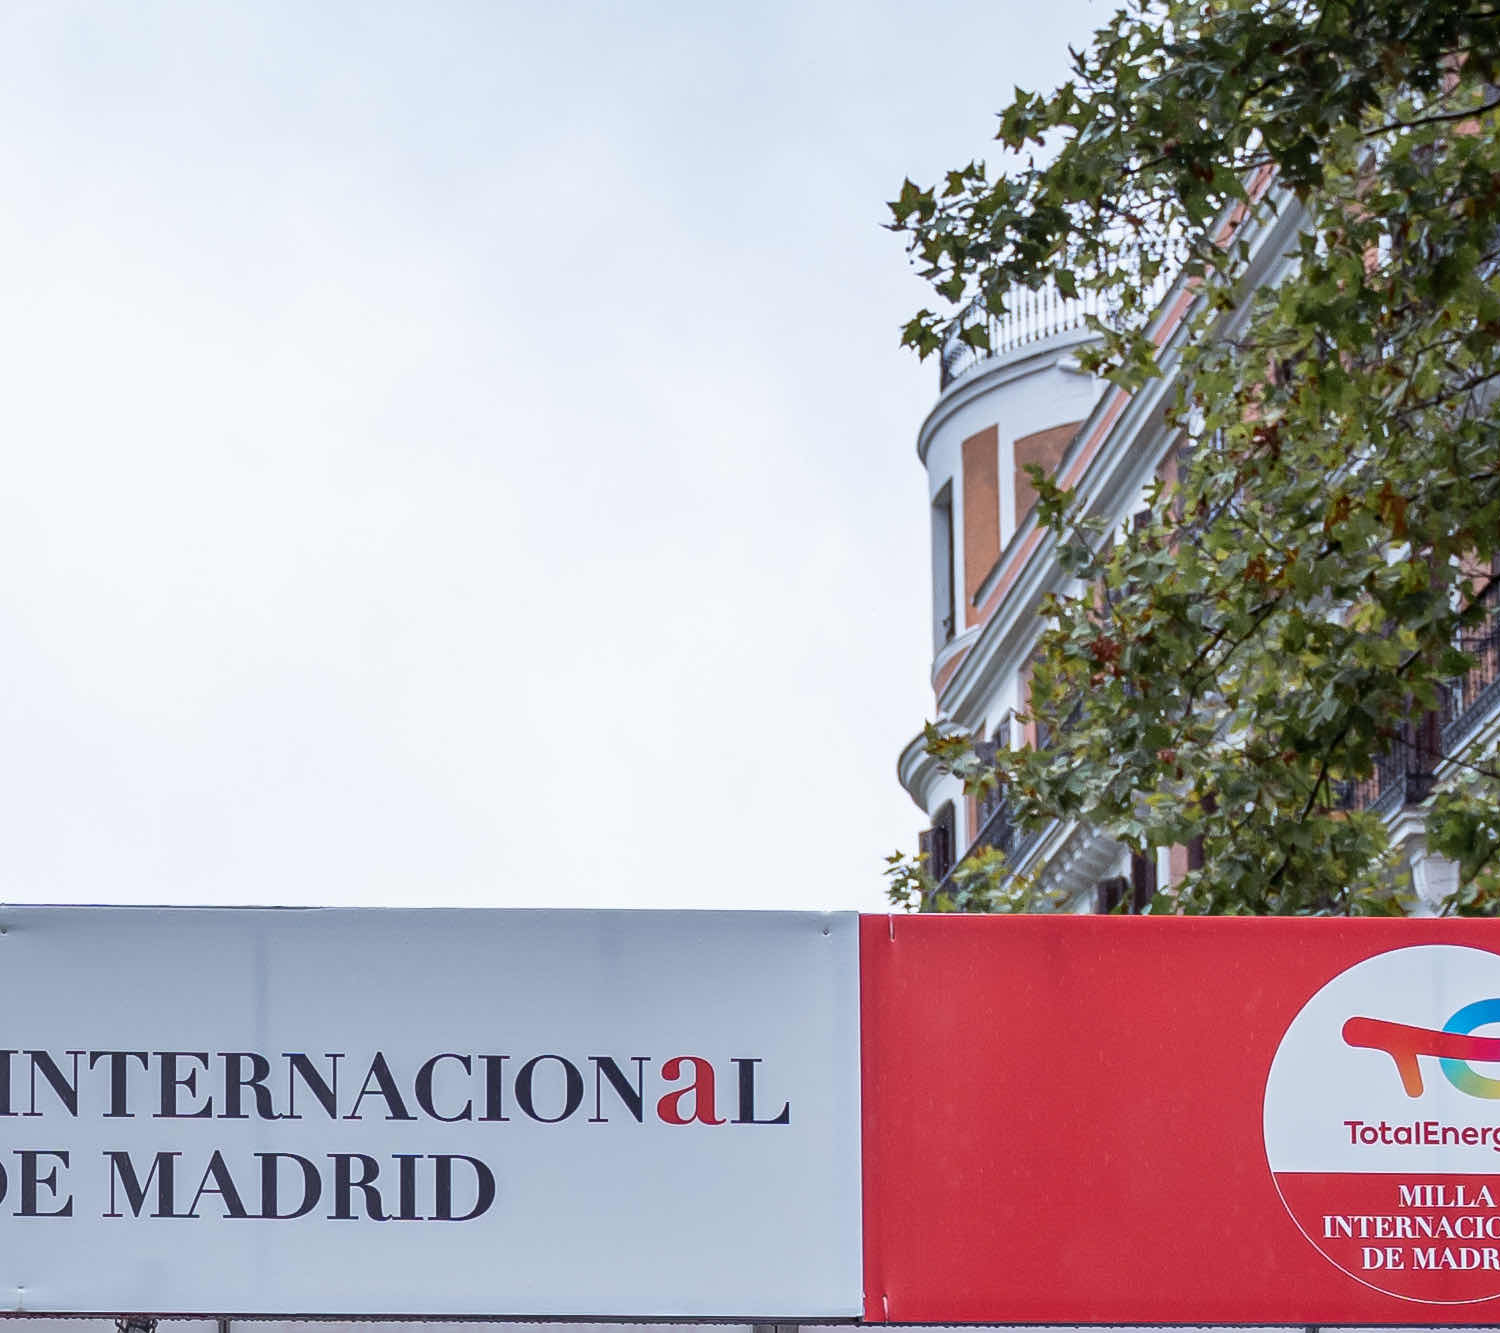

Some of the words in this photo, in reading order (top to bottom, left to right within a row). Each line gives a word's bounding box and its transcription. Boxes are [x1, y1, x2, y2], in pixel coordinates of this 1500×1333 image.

[101, 1152, 498, 1223] MADRID
[1397, 1184, 1497, 1208] MILLA
[1361, 1246, 1405, 1270] DE
